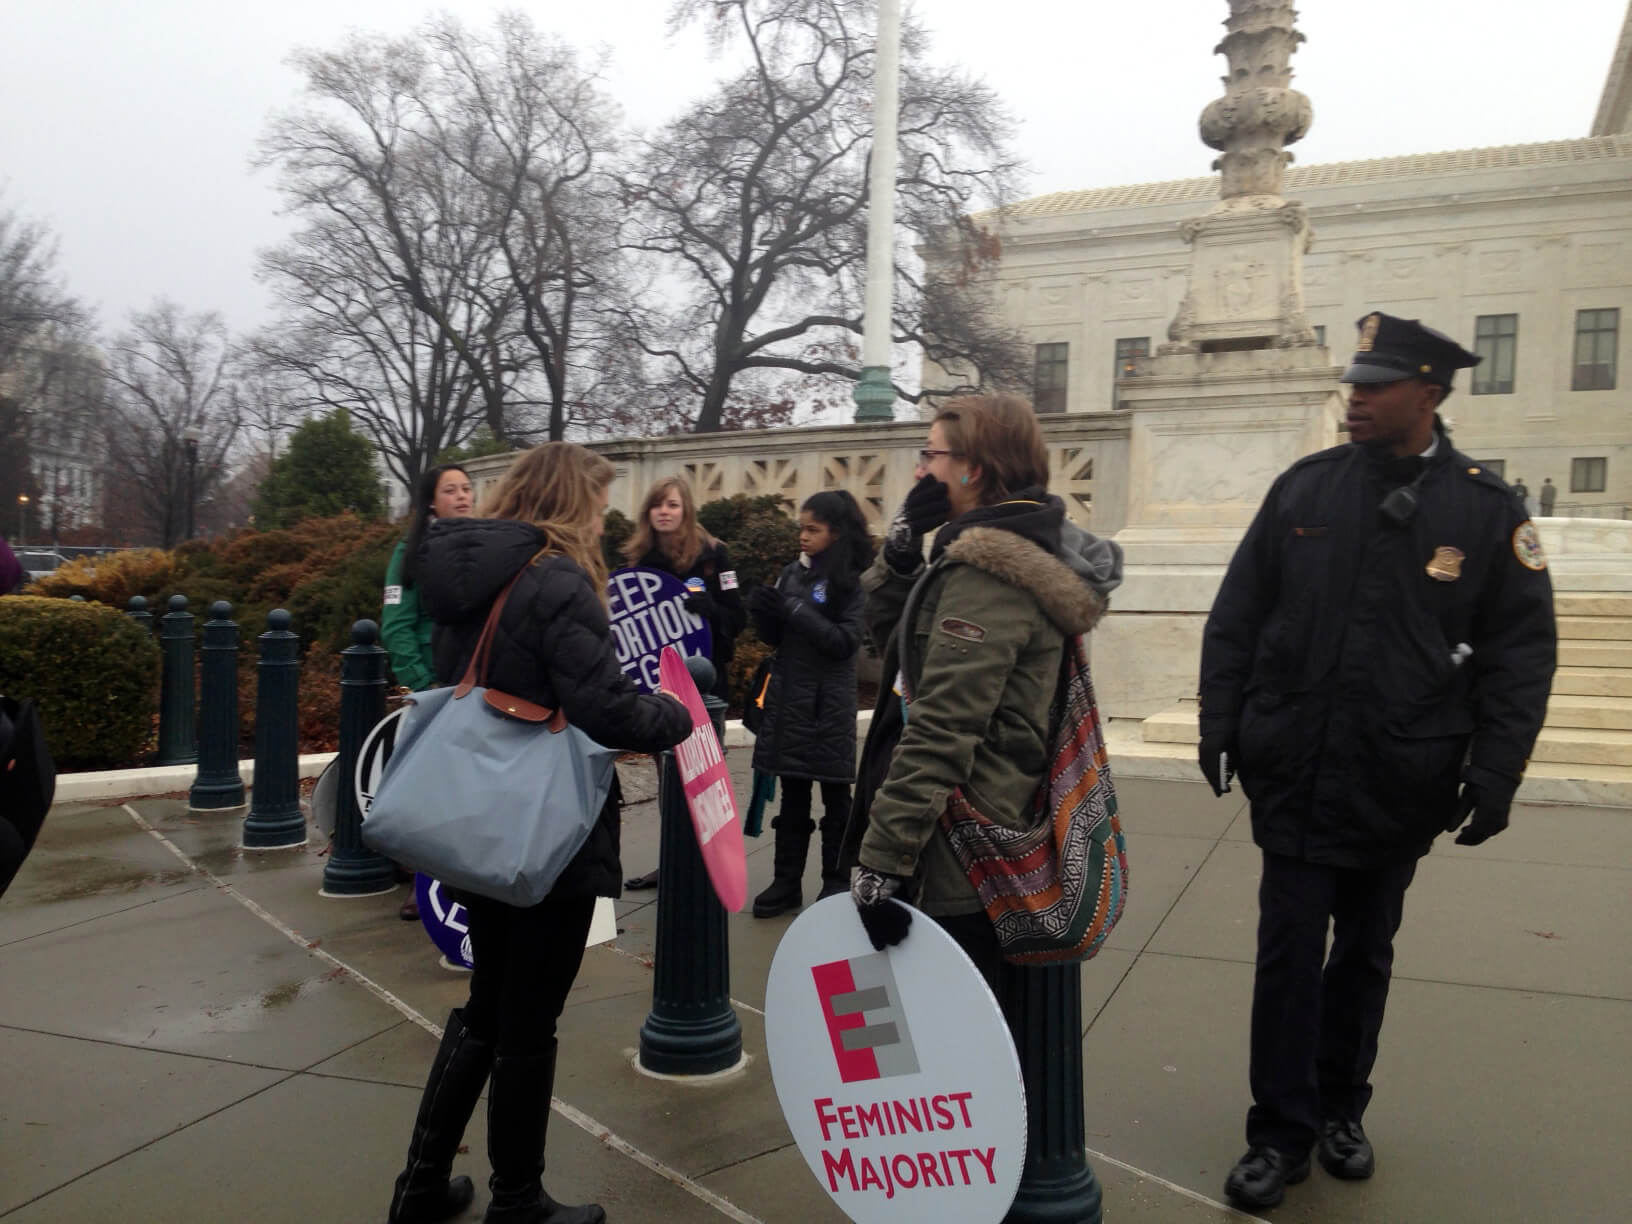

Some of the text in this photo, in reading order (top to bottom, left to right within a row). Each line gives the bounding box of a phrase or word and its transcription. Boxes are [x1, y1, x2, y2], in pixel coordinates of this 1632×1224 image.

[608, 571, 662, 621] EEP
[608, 591, 704, 663] ORTION
[814, 1091, 973, 1142] FEMINIST
[821, 1146, 997, 1200] MAJORITY
